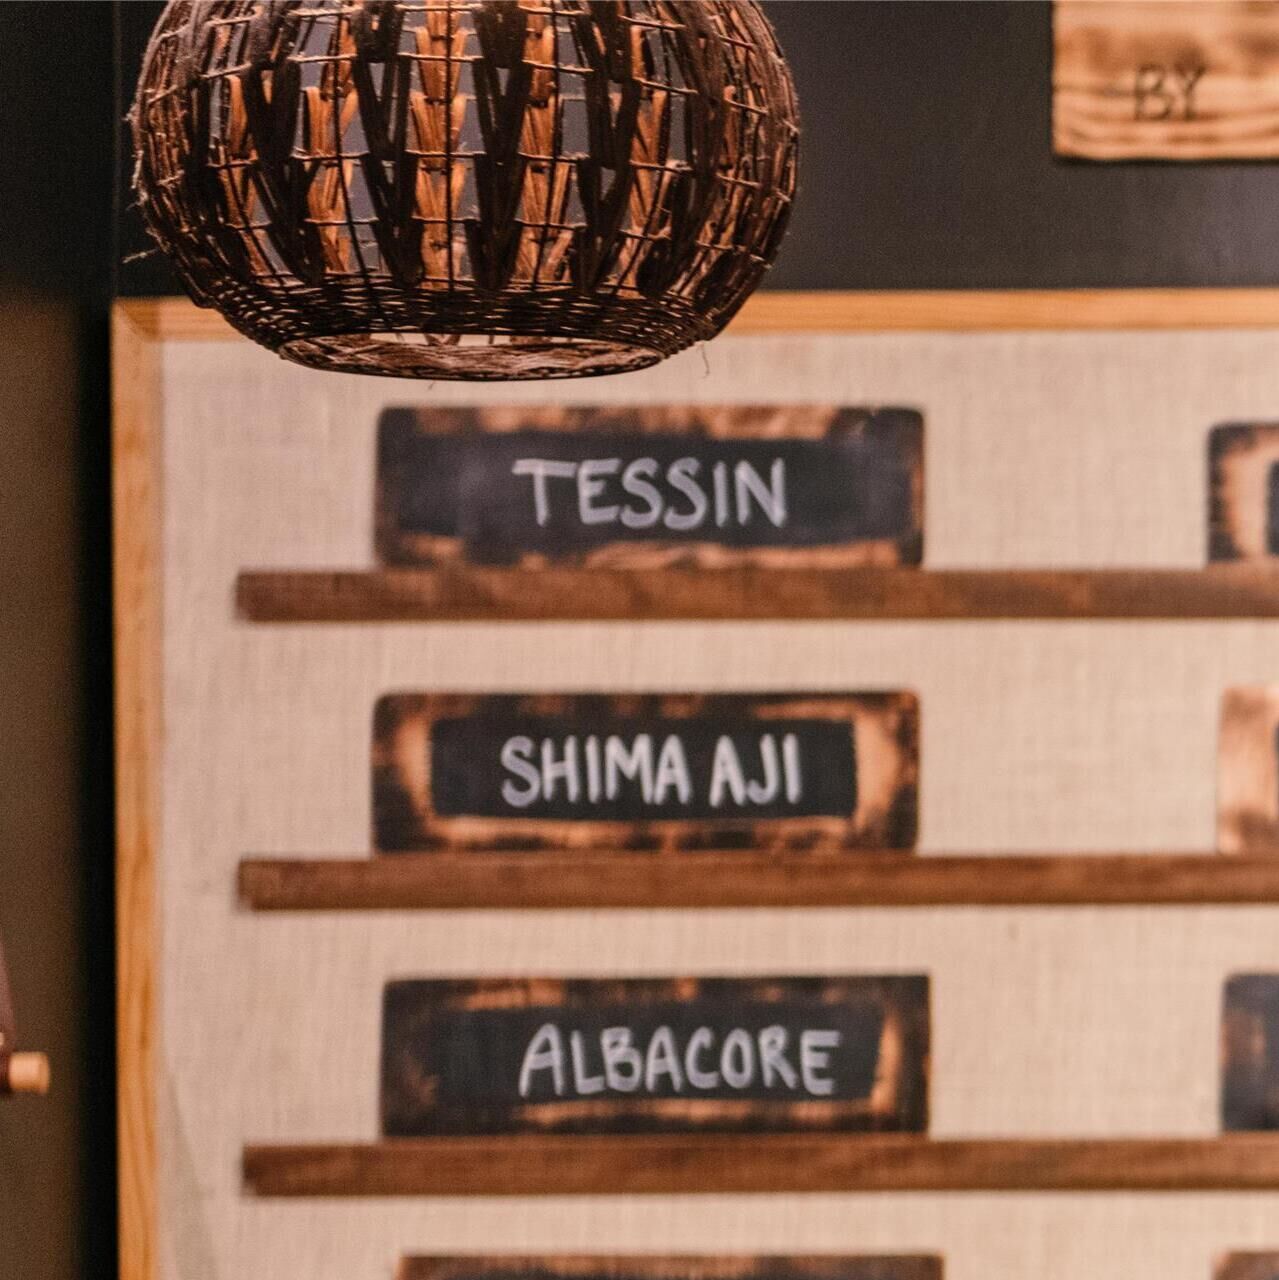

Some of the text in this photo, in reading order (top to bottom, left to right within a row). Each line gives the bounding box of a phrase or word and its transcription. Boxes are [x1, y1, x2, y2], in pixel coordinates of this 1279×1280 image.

[1133, 60, 1205, 123] BY
[513, 457, 788, 530] TESSIN
[500, 735, 801, 807] SHIMA AJI
[517, 1022, 843, 1099] ALBACORE
